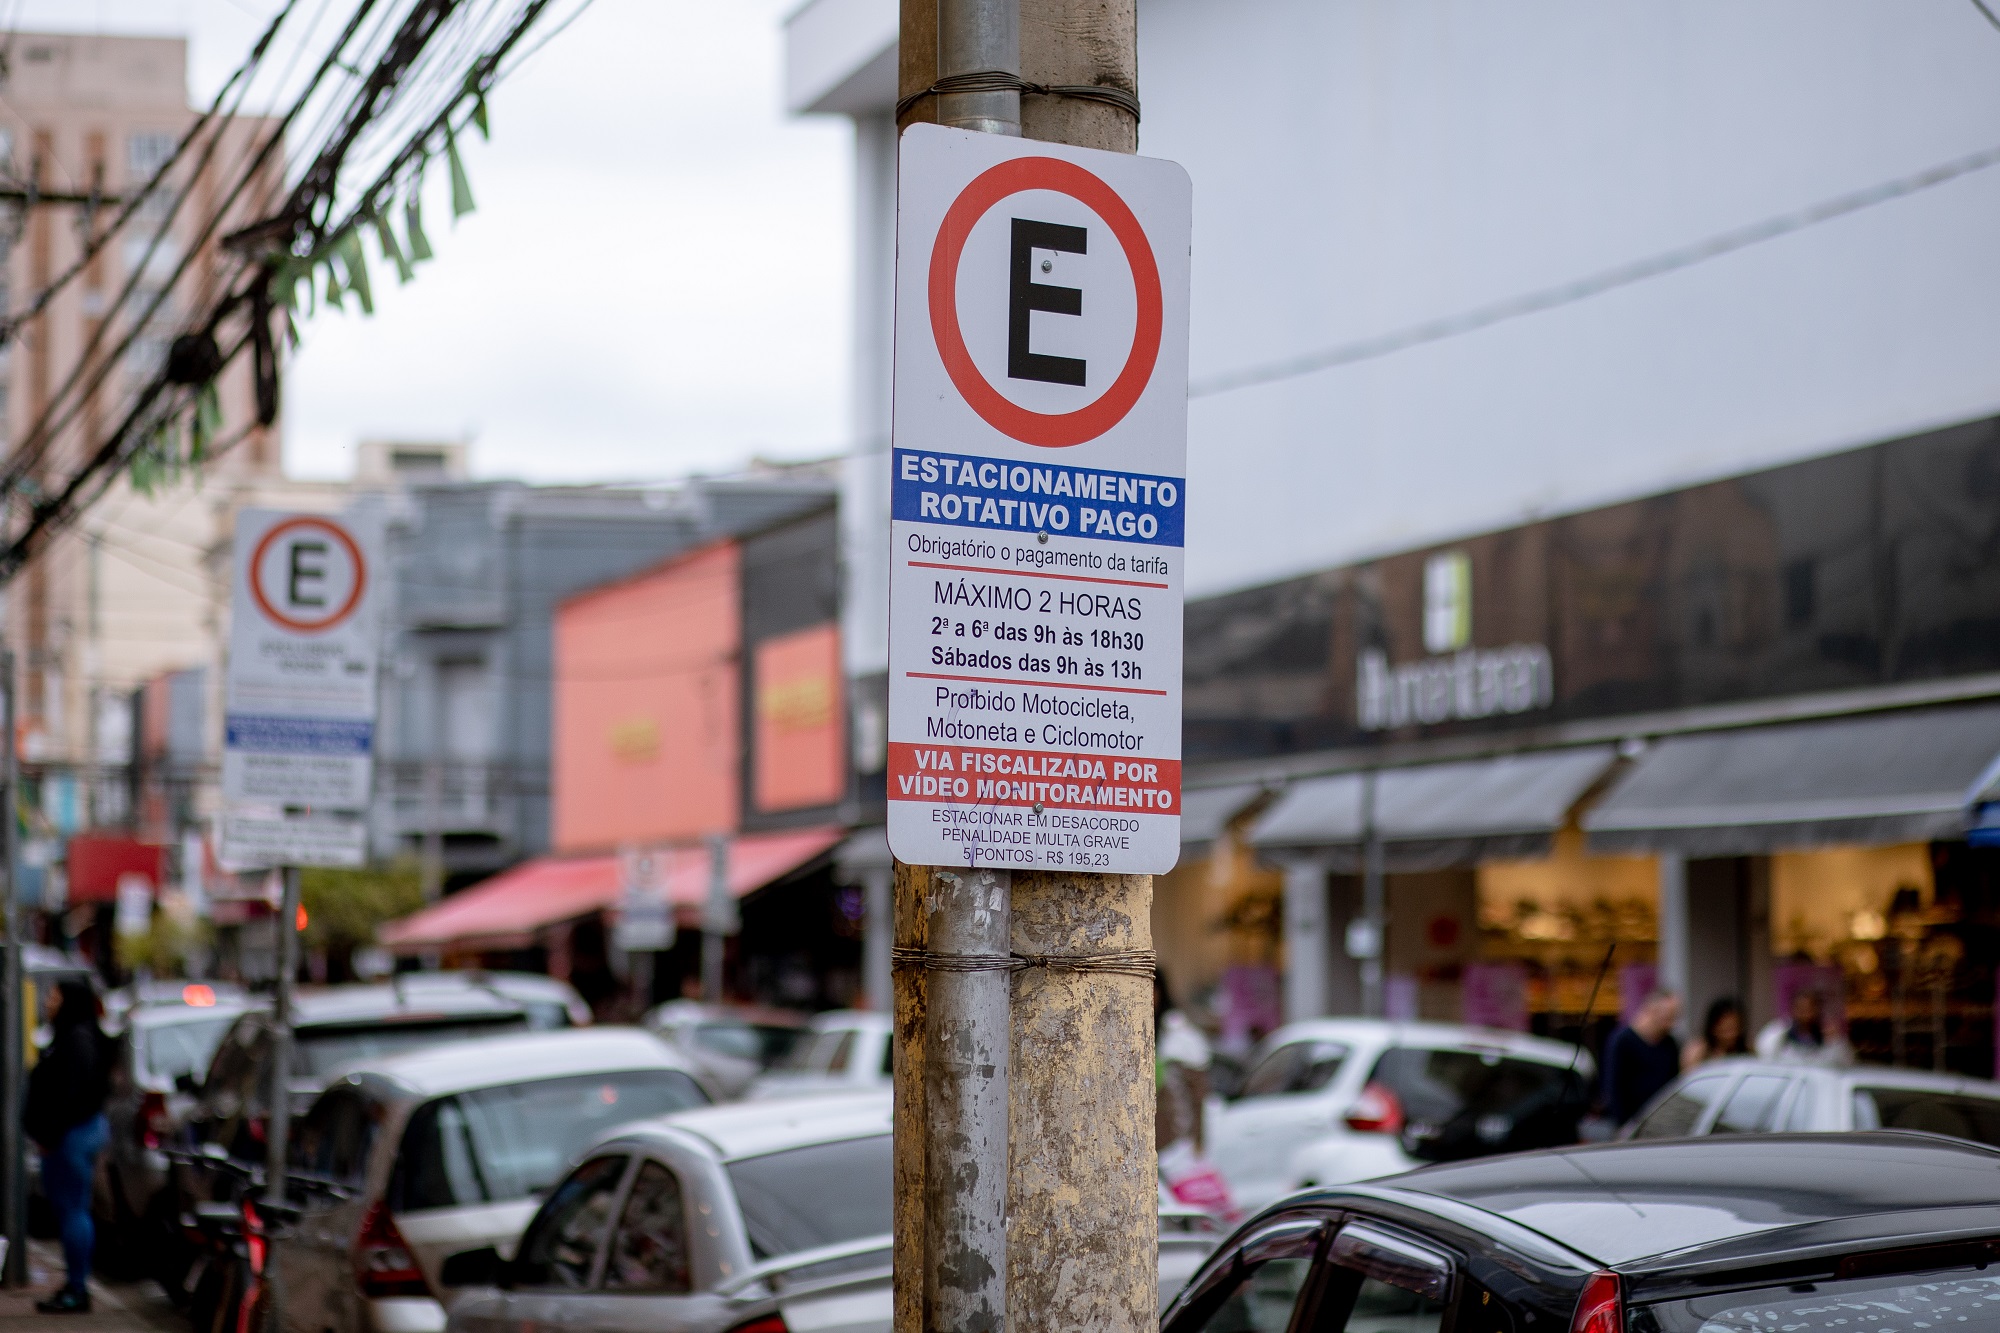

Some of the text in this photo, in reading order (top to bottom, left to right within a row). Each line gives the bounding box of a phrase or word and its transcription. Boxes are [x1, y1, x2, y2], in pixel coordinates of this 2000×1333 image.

[1008, 217, 1087, 387] E
[901, 454, 1177, 507] ESTACIONAMENTO
[920, 492, 1158, 538] ROTATIVO PAGO
[908, 534, 1168, 575] Obrigatório o pagamento da tarifa
[289, 543, 328, 605] E
[934, 578, 1142, 620] MÁXIMO 2 HORAS
[955, 622, 965, 636] a
[994, 622, 1027, 642] das
[1034, 626, 1056, 644] 9h
[1062, 628, 1083, 646] às
[1091, 630, 1144, 651] 18h30
[932, 646, 1142, 679] Sábados das 9h às 13h
[936, 687, 1135, 723] Proibido Motocicleta,
[928, 717, 1144, 750] Motoneta e Ciclomotor
[915, 750, 1158, 782] VIA FISCALIZADA POR
[898, 772, 1172, 808] VÍDEO MONITORAMENTO
[932, 810, 1139, 832] ESTACIONAR EM DESACORDO
[942, 828, 1130, 849] PENALIDADE MULTA GRAVE
[963, 848, 970, 860] 5
[975, 849, 1033, 862] PONTOS
[1046, 851, 1064, 864] R$
[1069, 852, 1109, 866] 195,23
